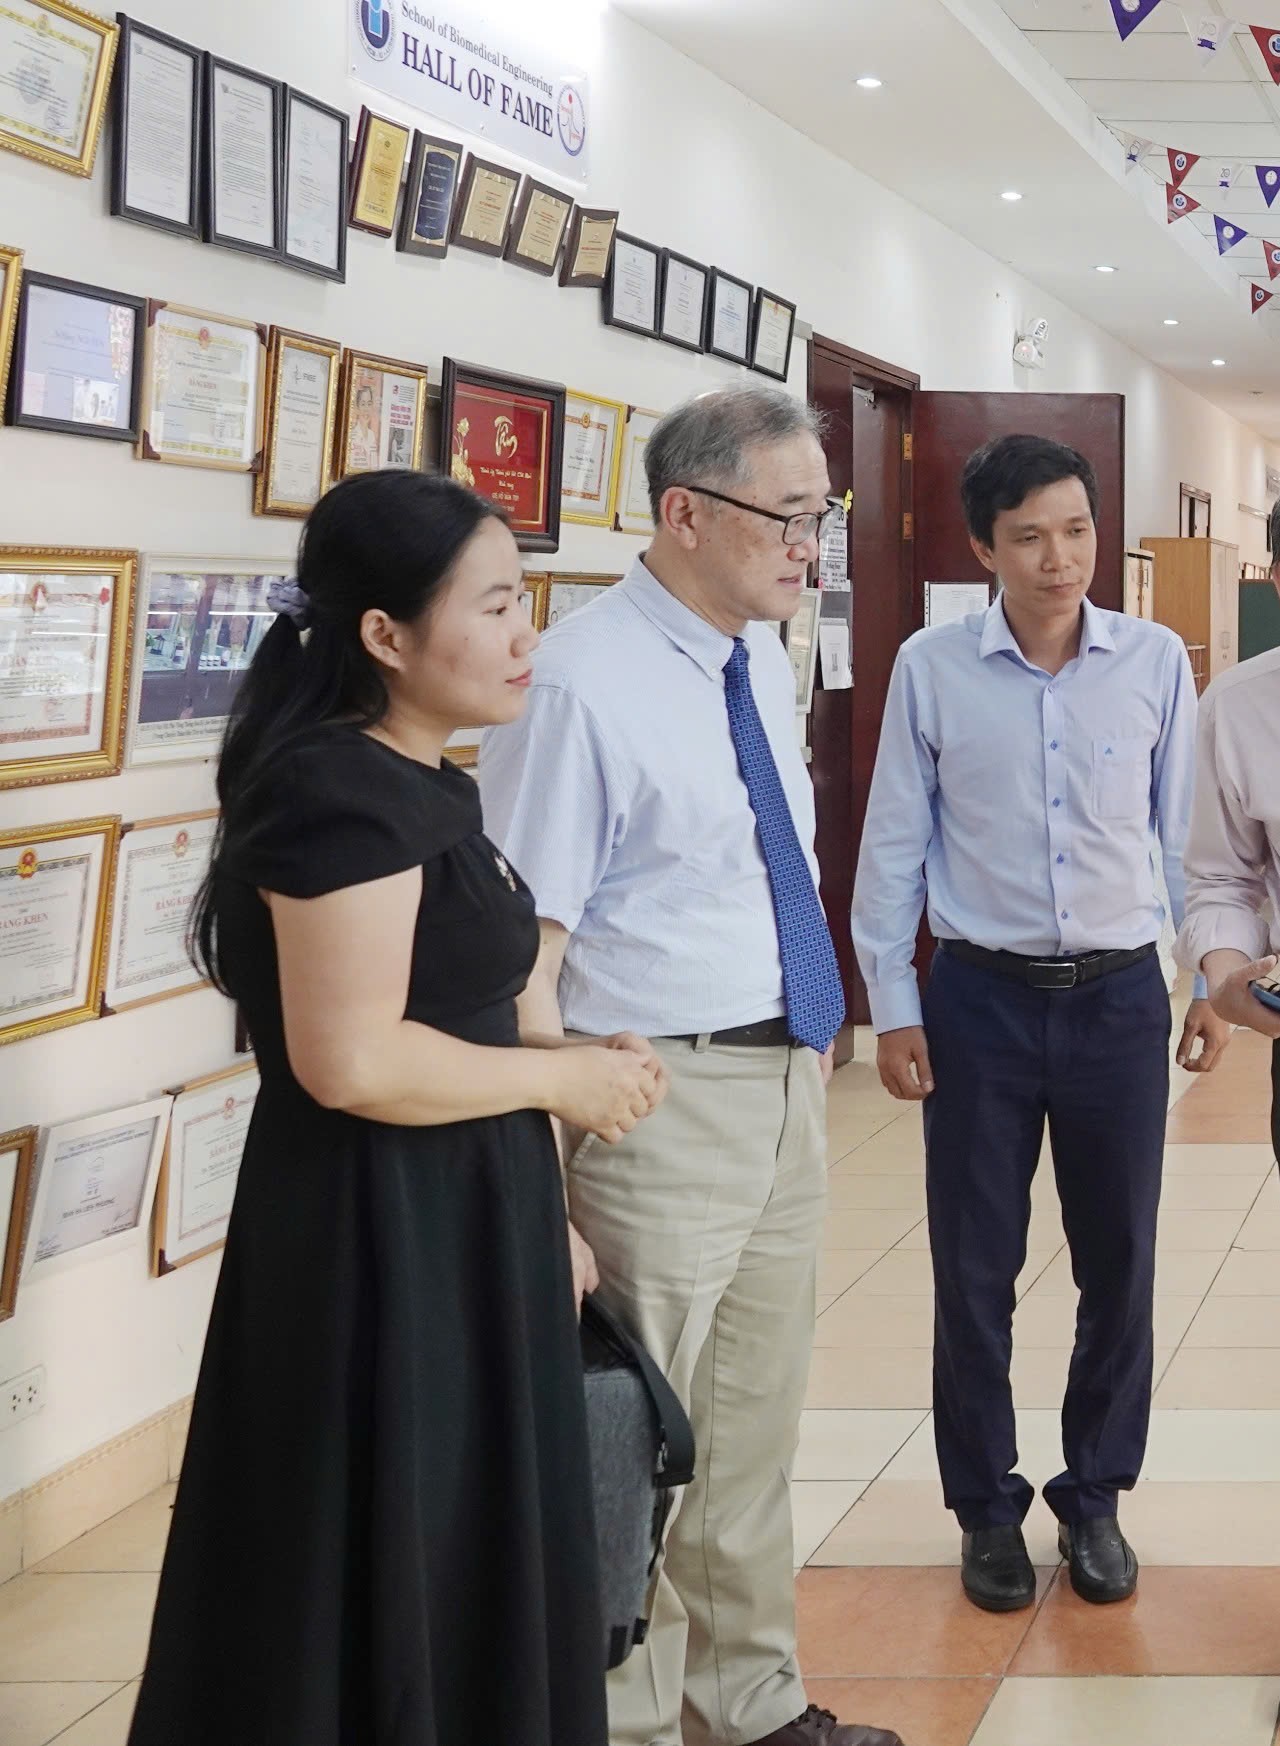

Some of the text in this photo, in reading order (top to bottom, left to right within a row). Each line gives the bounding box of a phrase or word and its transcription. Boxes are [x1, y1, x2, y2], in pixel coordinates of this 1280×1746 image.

[402, 0, 435, 32] School
[438, 23, 448, 38] of
[450, 26, 500, 67] Biomedical
[502, 54, 553, 98] Engineering
[402, 32, 463, 92] HALL
[468, 67, 496, 106] OF
[500, 83, 553, 138] FAME
